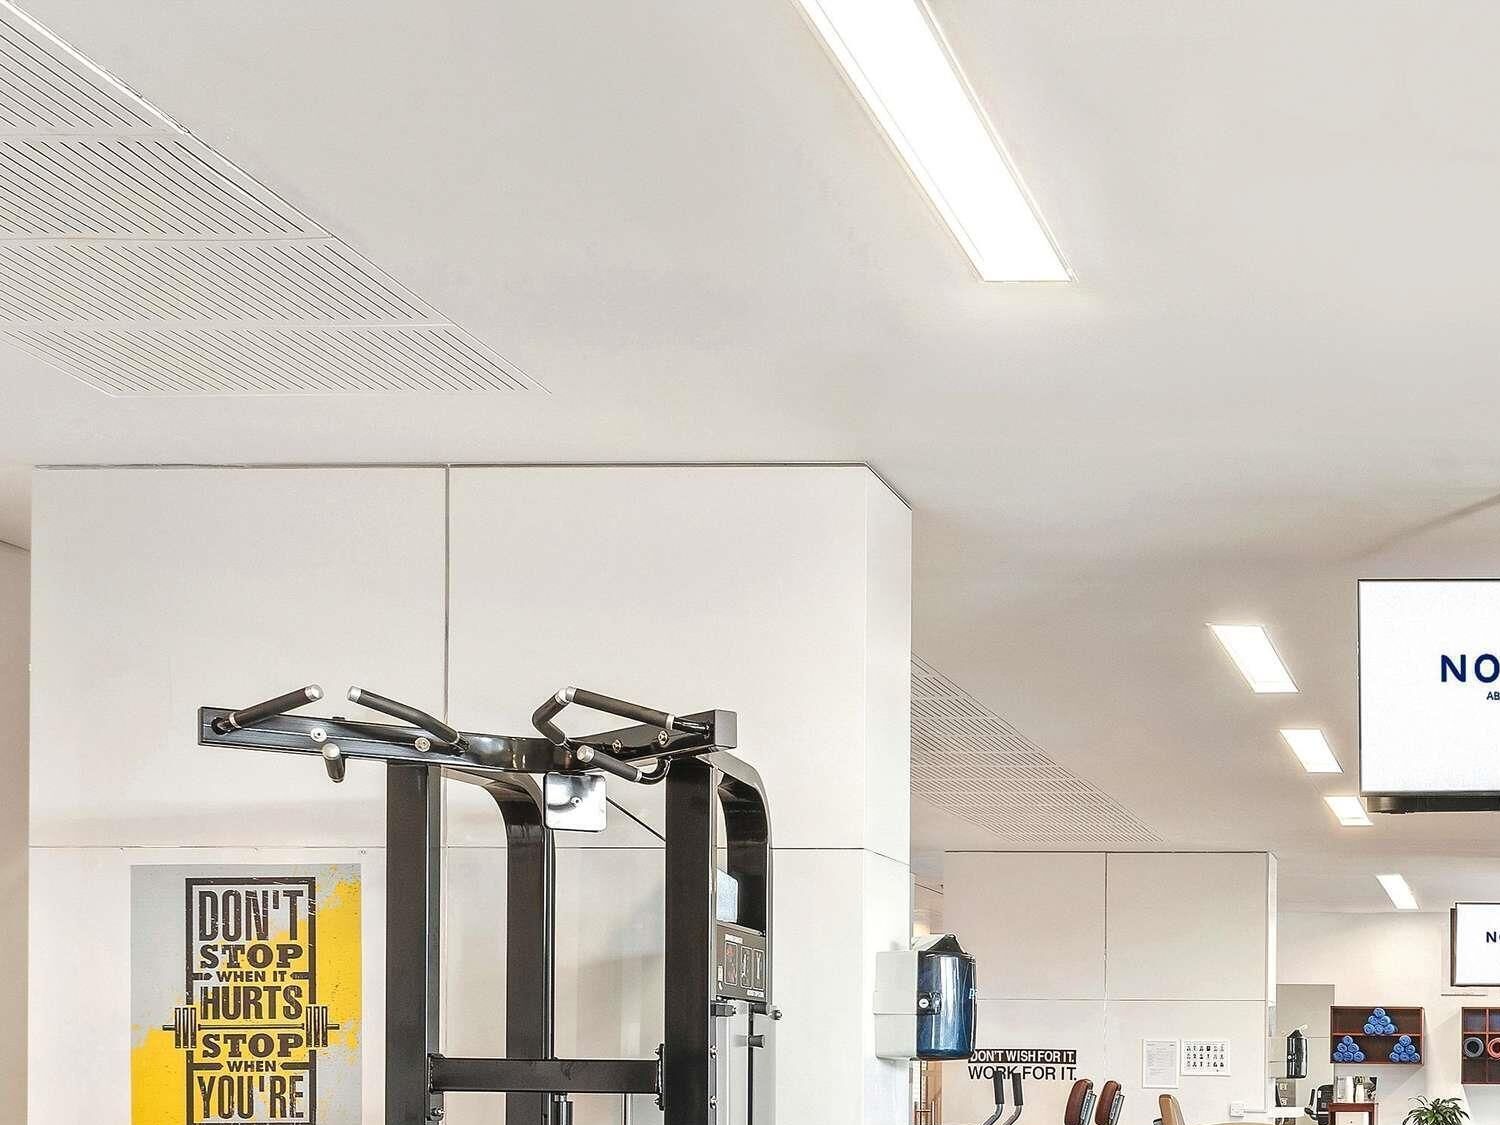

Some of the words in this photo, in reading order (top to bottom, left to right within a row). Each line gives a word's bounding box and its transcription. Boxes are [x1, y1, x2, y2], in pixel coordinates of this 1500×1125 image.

[198, 889, 304, 942] DON'T
[200, 944, 304, 969] STOP
[216, 971, 266, 983] WHEN
[273, 971, 287, 982] IT
[200, 986, 304, 1021] HURTS
[202, 1033, 304, 1058] STOP
[971, 1050, 1004, 1062] DON'T
[1006, 1050, 1036, 1062] WISH
[1037, 1051, 1061, 1062] FOR
[1063, 1051, 1075, 1063] IT.
[227, 1060, 276, 1072] WHEN
[968, 1065, 1018, 1080] WORK
[1022, 1066, 1056, 1080] FOR
[1061, 1066, 1077, 1081] IT.
[197, 1075, 304, 1119] YOU'RE
